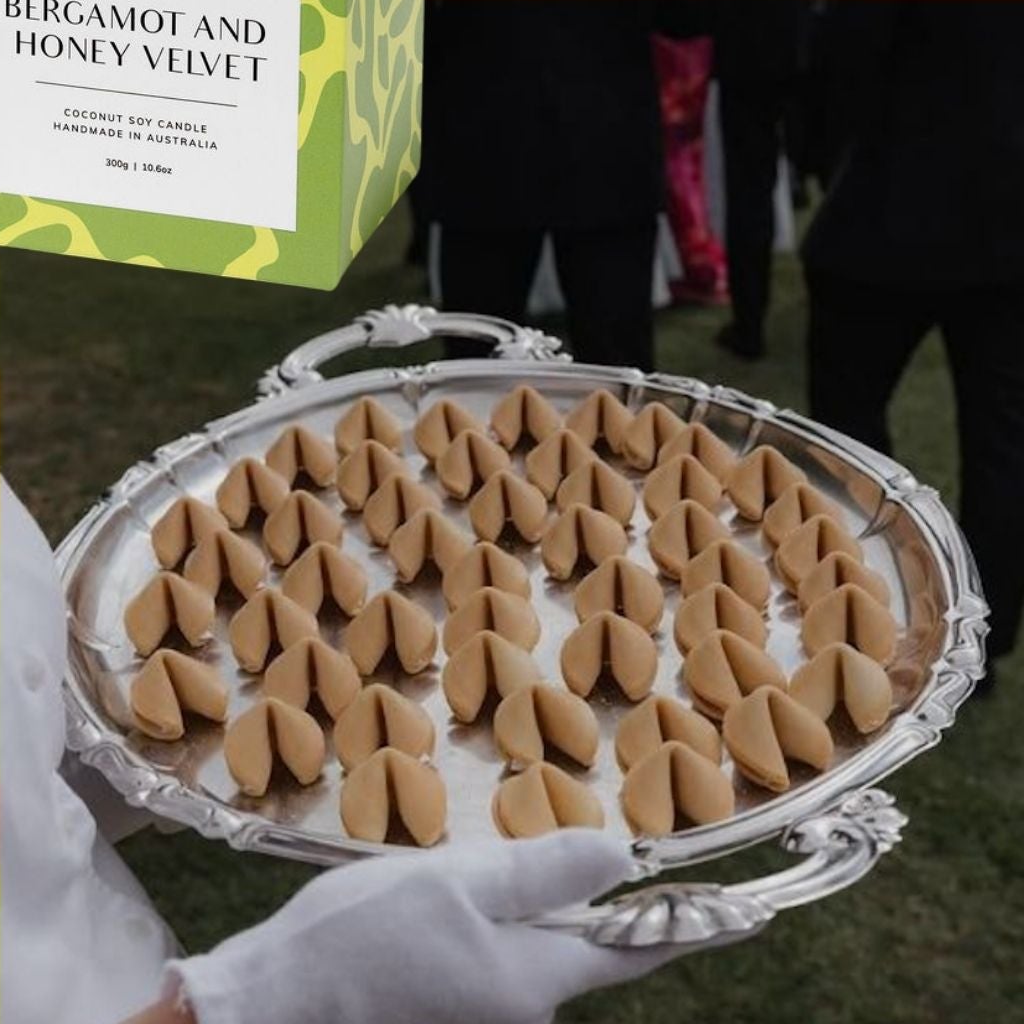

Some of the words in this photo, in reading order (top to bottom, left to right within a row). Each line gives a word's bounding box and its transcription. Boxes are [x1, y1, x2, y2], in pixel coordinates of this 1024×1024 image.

[193, 14, 267, 45] AND
[14, 29, 131, 67] HONEY
[142, 44, 268, 82] VELVET
[52, 121, 124, 139] HANDMADE
[128, 131, 142, 141] IN
[146, 133, 219, 151] AUSTRALIA
[63, 108, 124, 124] COCONUT
[128, 115, 153, 127] SOY
[157, 119, 208, 134] CANDLE
[104, 157, 129, 171] 300g
[142, 162, 173, 175] 10.6oz
